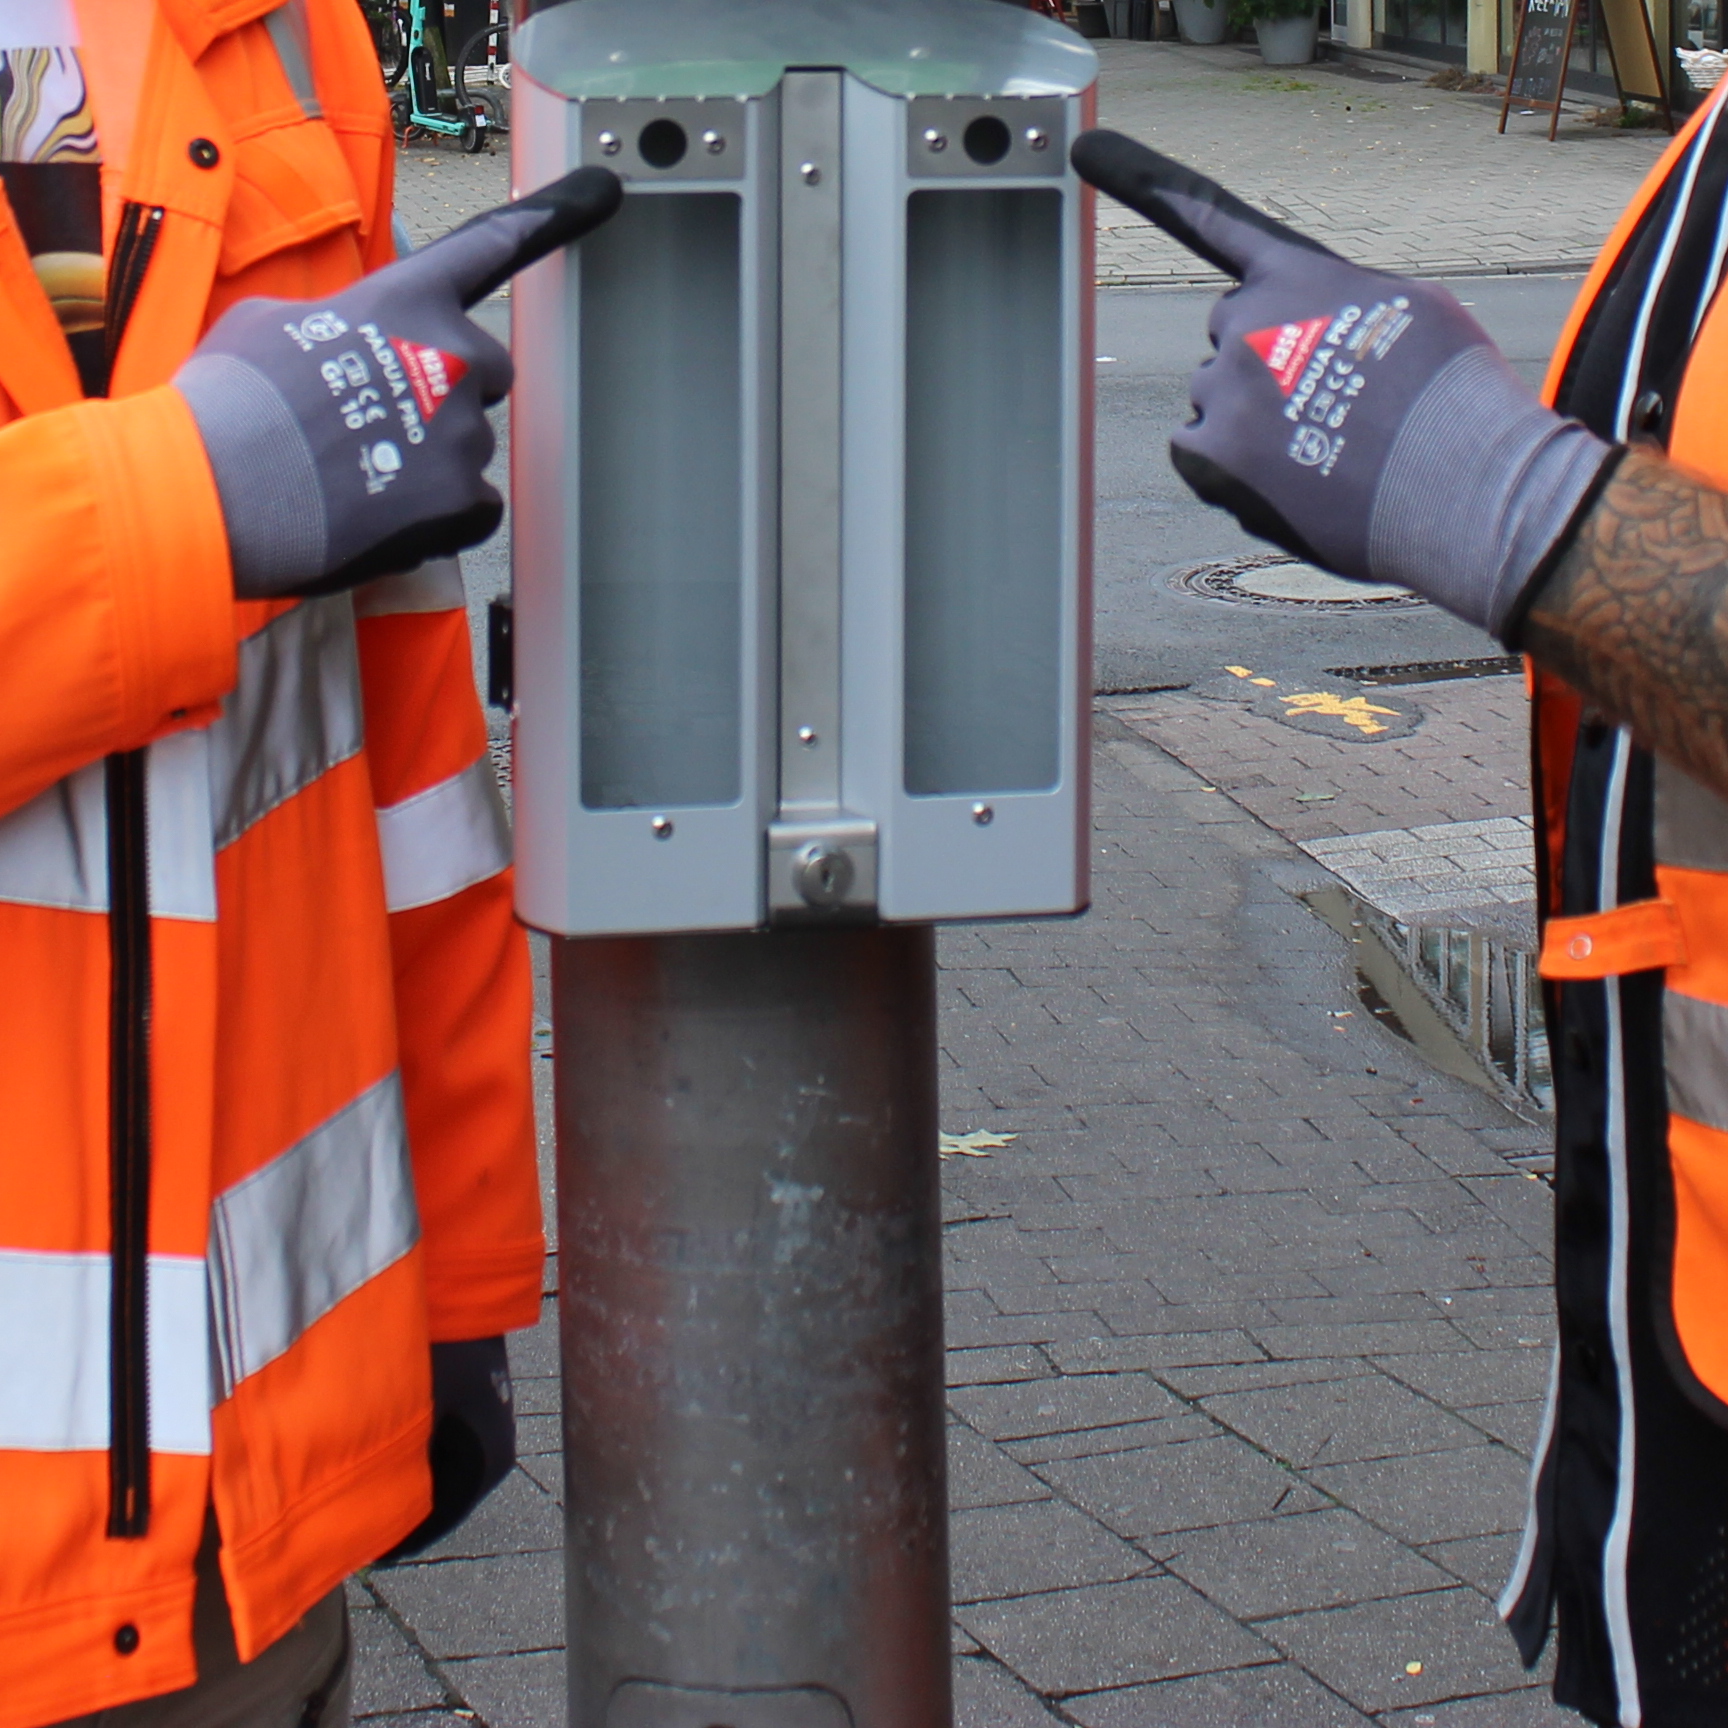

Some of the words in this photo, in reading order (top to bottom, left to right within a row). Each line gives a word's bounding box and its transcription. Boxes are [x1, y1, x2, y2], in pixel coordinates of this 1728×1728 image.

[321, 360, 347, 397] Gr.
[340, 398, 365, 430] 10
[357, 323, 408, 398] PADUA
[396, 398, 425, 445] PRO
[1283, 348, 1335, 422] PADUA
[1324, 304, 1362, 346] PRO
[1342, 373, 1365, 397] 10
